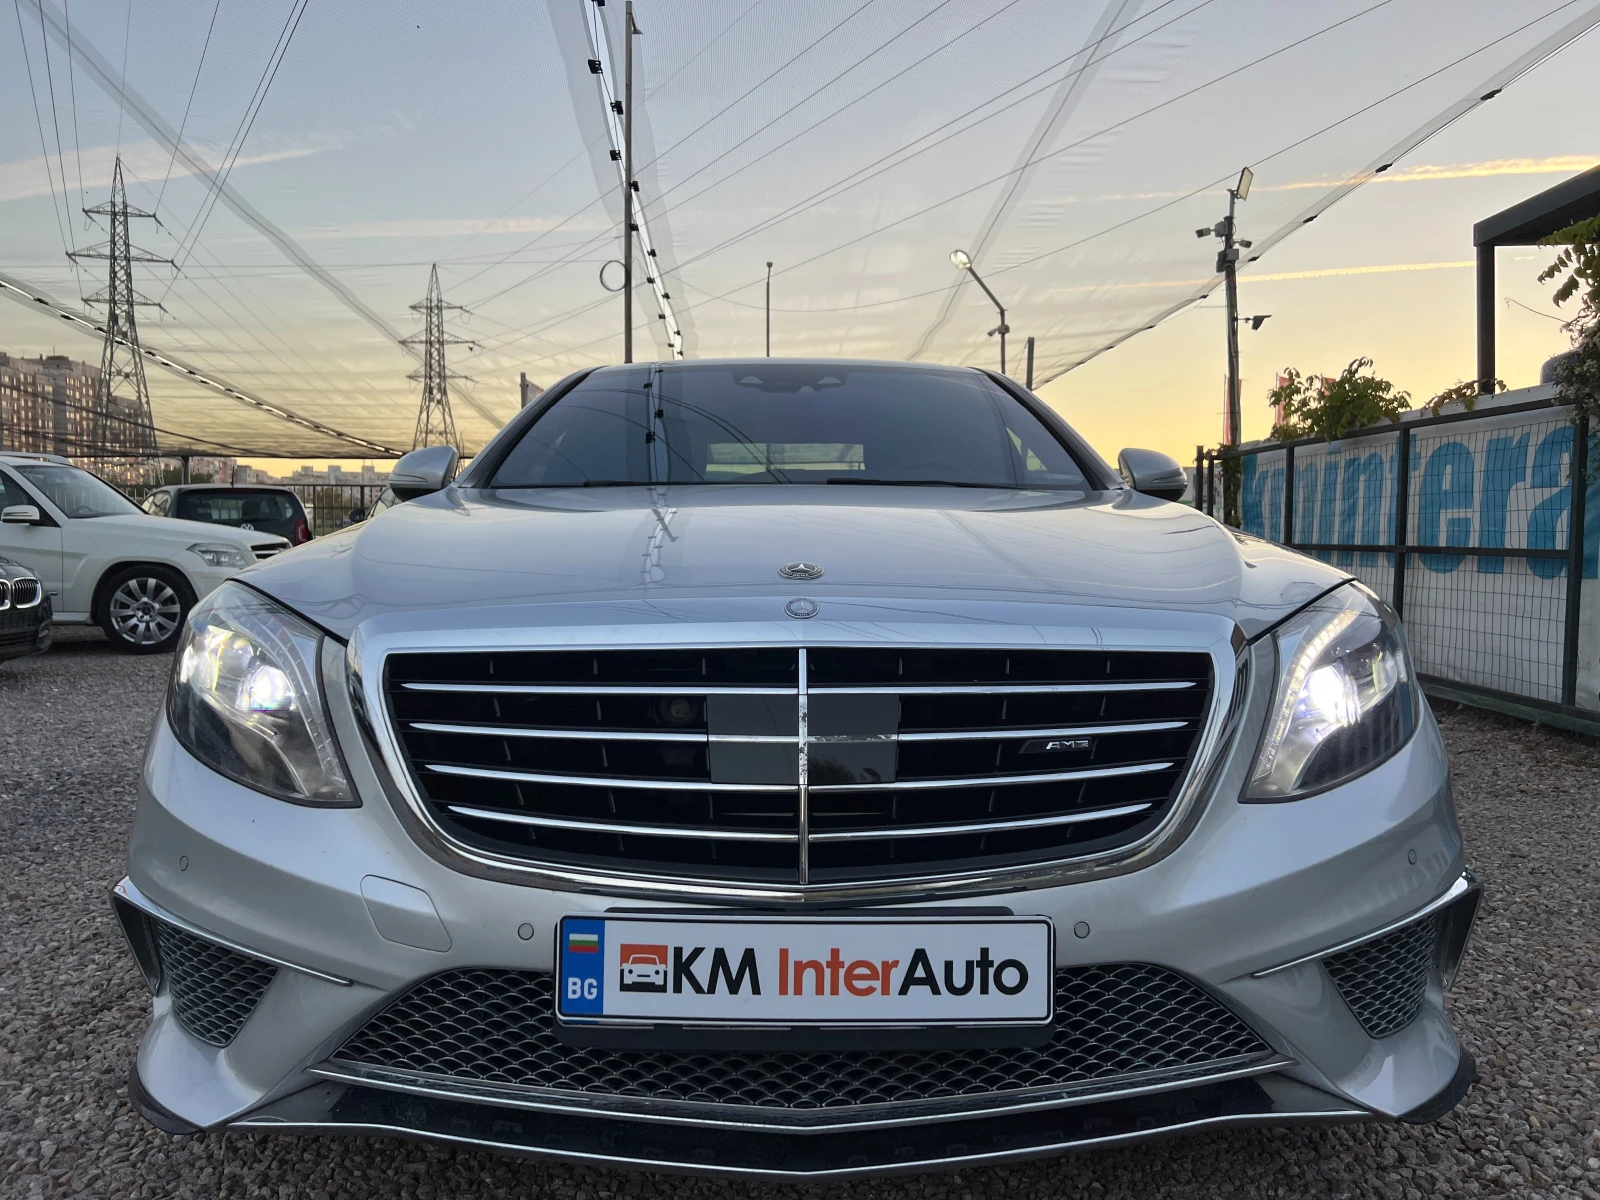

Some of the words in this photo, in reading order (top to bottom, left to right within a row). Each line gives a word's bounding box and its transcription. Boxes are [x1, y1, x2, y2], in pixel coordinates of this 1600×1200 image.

[567, 976, 599, 1000] BG
[672, 946, 762, 996] KM
[778, 946, 1029, 997] InterAuto
